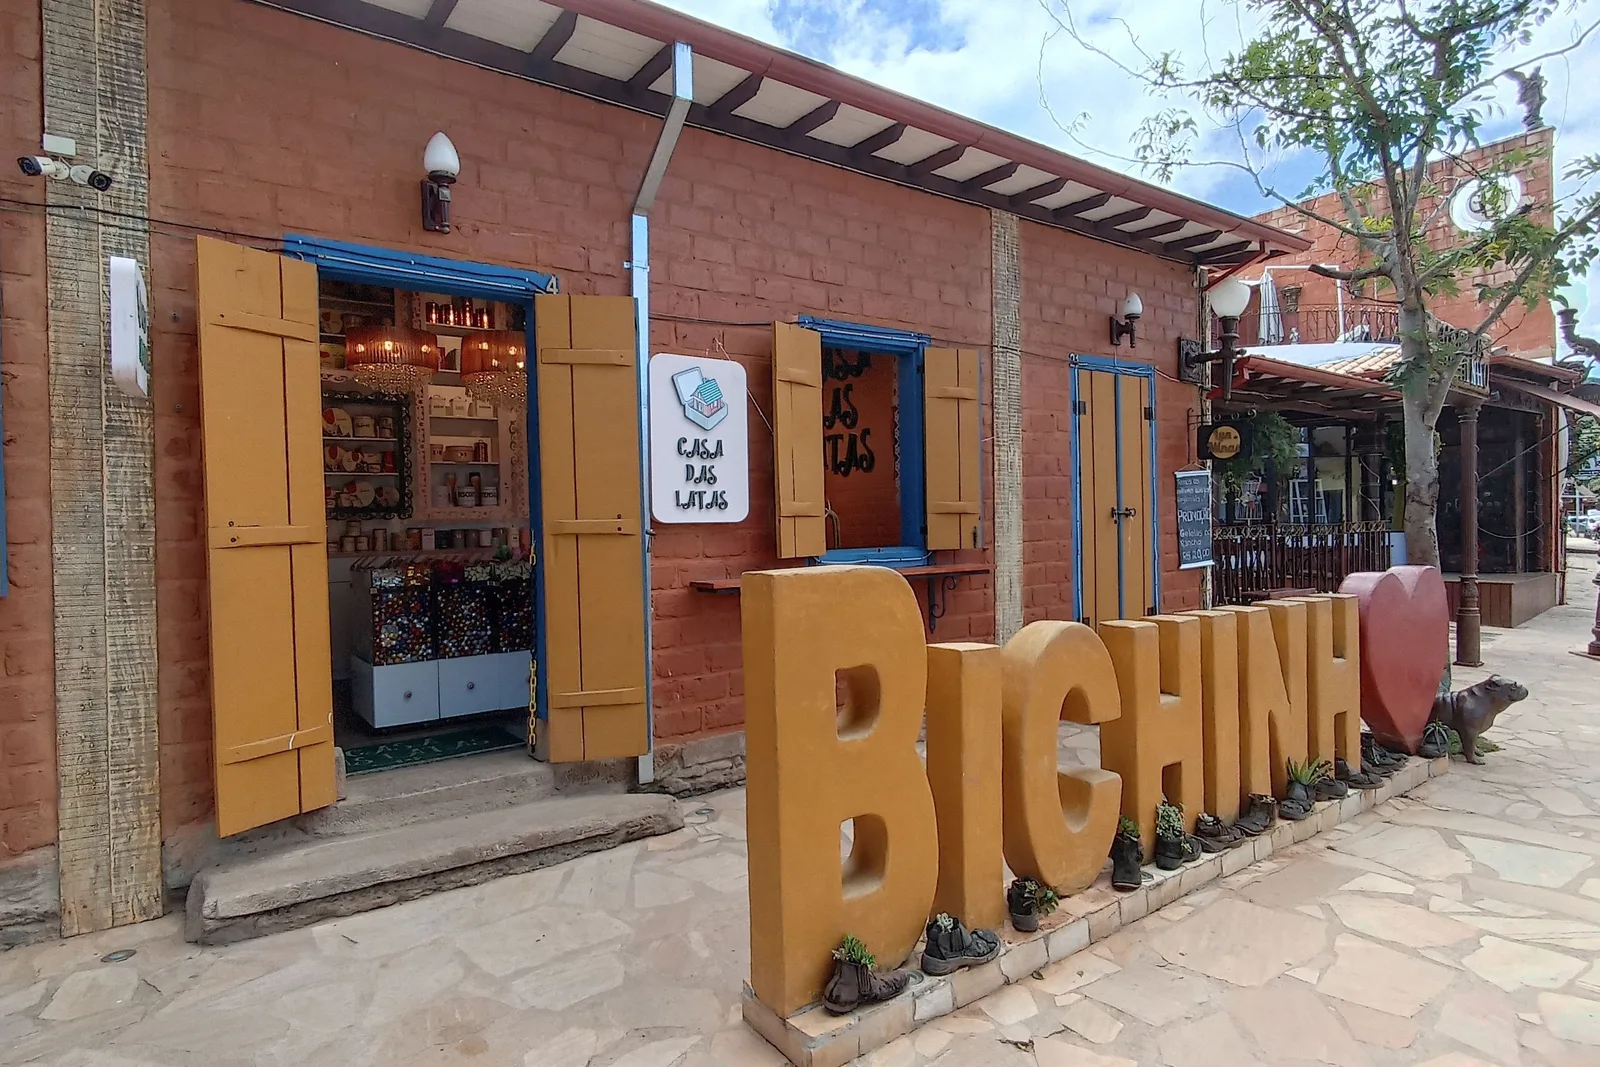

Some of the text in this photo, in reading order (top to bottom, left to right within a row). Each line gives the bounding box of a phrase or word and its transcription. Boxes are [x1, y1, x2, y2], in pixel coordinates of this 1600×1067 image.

[546, 274, 558, 294] 4
[823, 383, 858, 430] AS
[677, 437, 724, 460] CASA
[823, 428, 875, 477] TAS
[685, 463, 718, 485] DAS
[674, 490, 728, 511] LATAS
